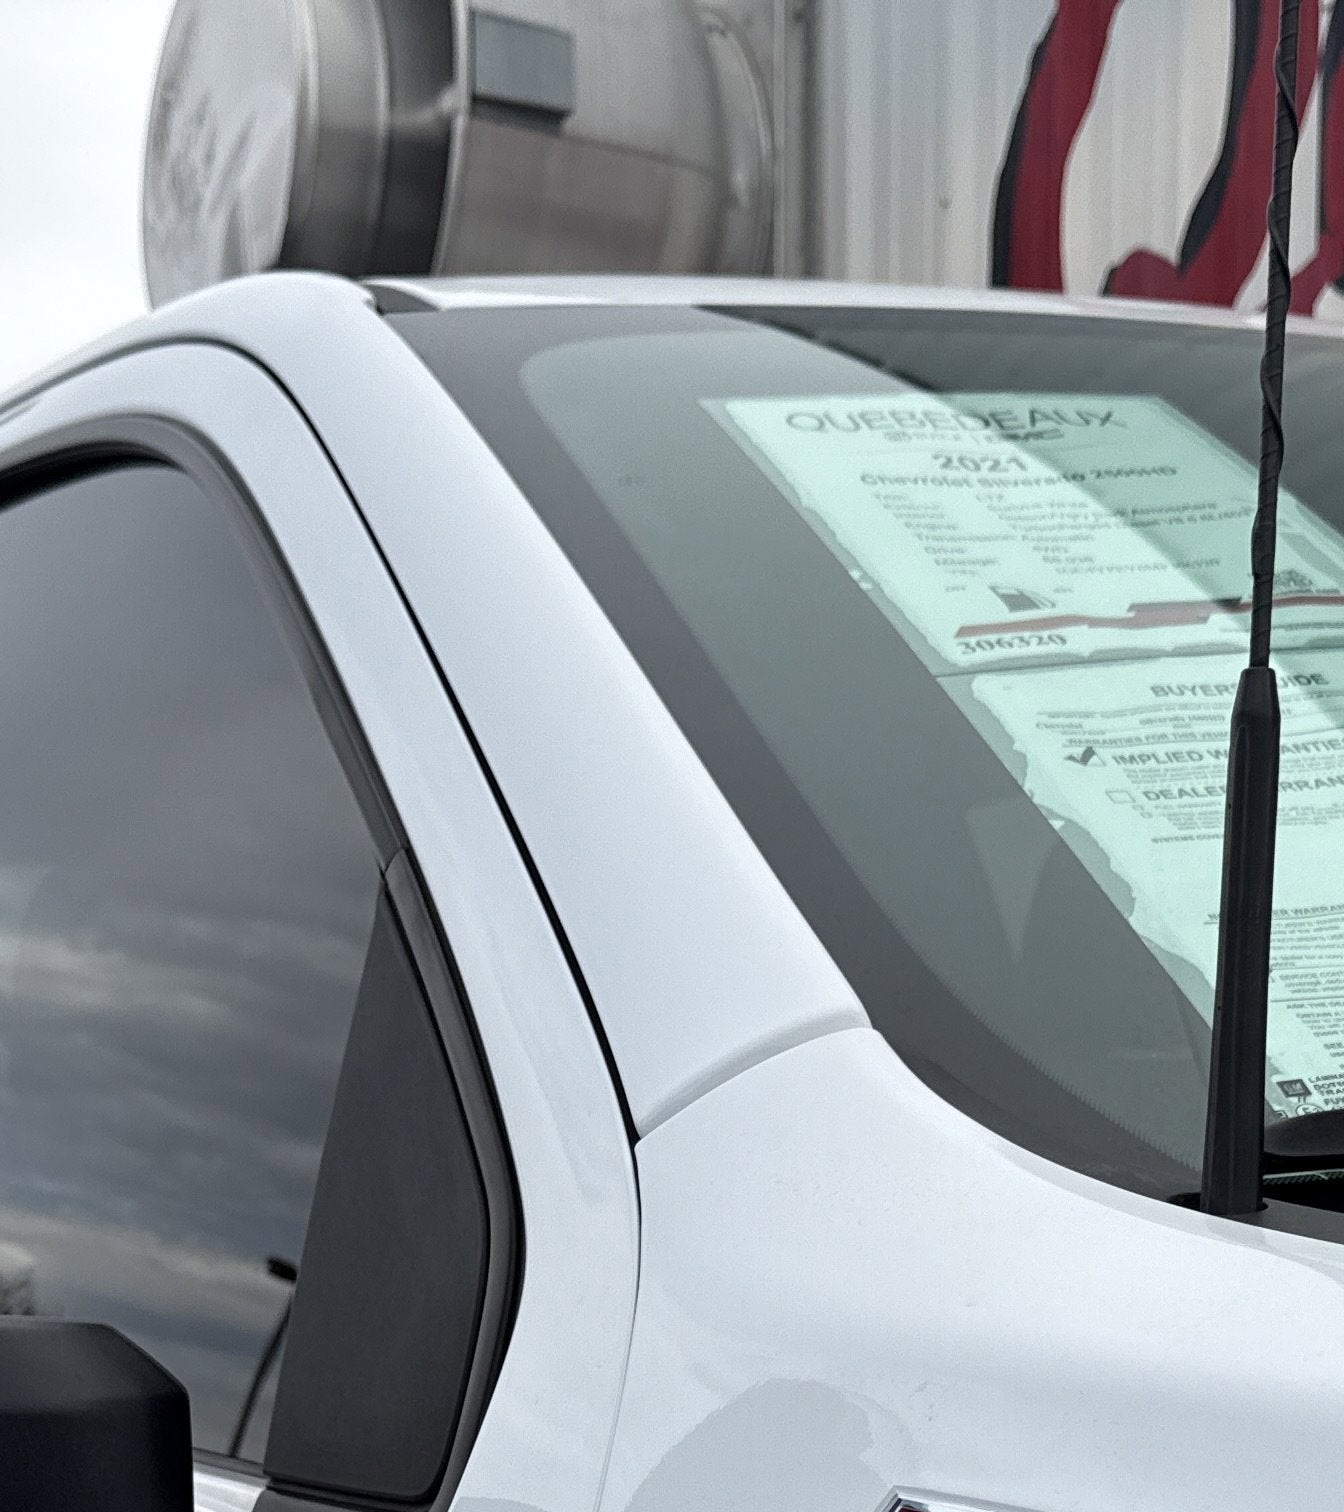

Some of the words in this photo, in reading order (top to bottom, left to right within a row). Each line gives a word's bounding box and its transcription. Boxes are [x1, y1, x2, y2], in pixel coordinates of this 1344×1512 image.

[785, 407, 1128, 432] QUEBEDEAUX
[932, 452, 1029, 473] 2021
[859, 472, 972, 489] Chevrolet
[959, 631, 1068, 655] 306320
[1111, 750, 1204, 766] IMPLIED
